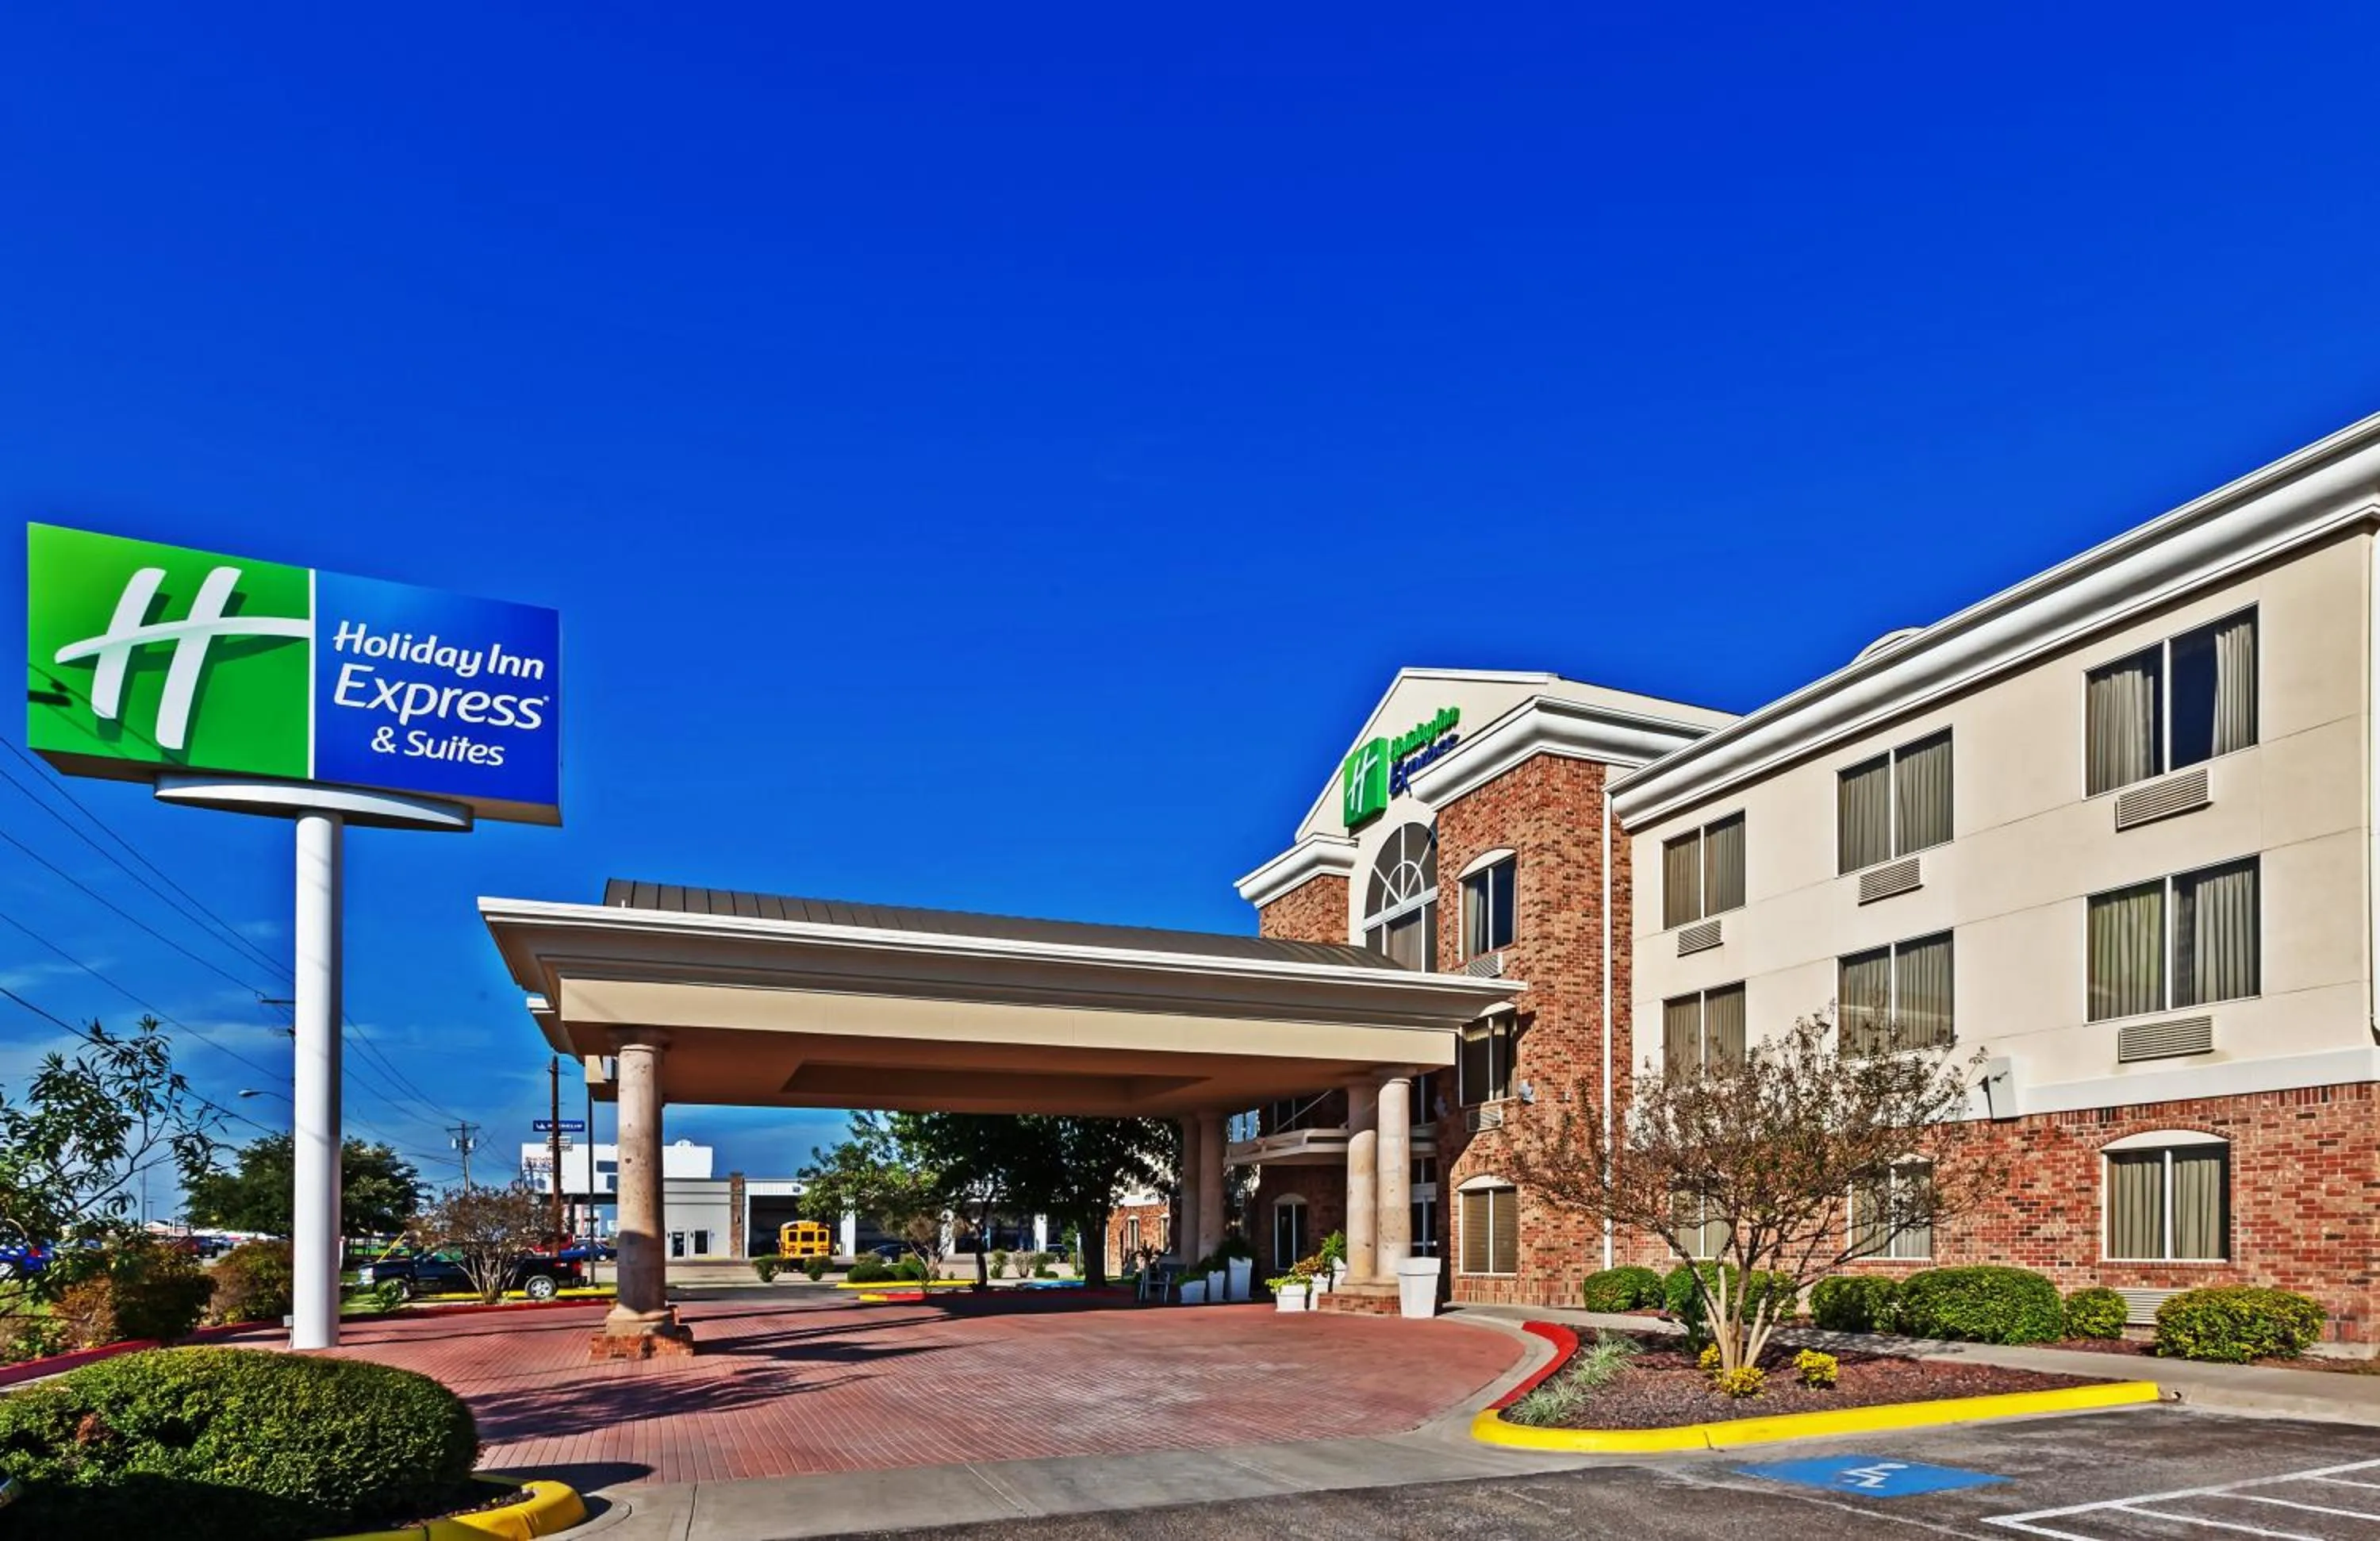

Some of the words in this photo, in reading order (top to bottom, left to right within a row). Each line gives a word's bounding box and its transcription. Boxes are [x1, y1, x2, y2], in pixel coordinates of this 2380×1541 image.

[332, 620, 483, 678] Holiday
[487, 644, 545, 680] Inn
[333, 663, 544, 730] Express
[370, 726, 397, 754] &
[404, 730, 505, 767] Suites
